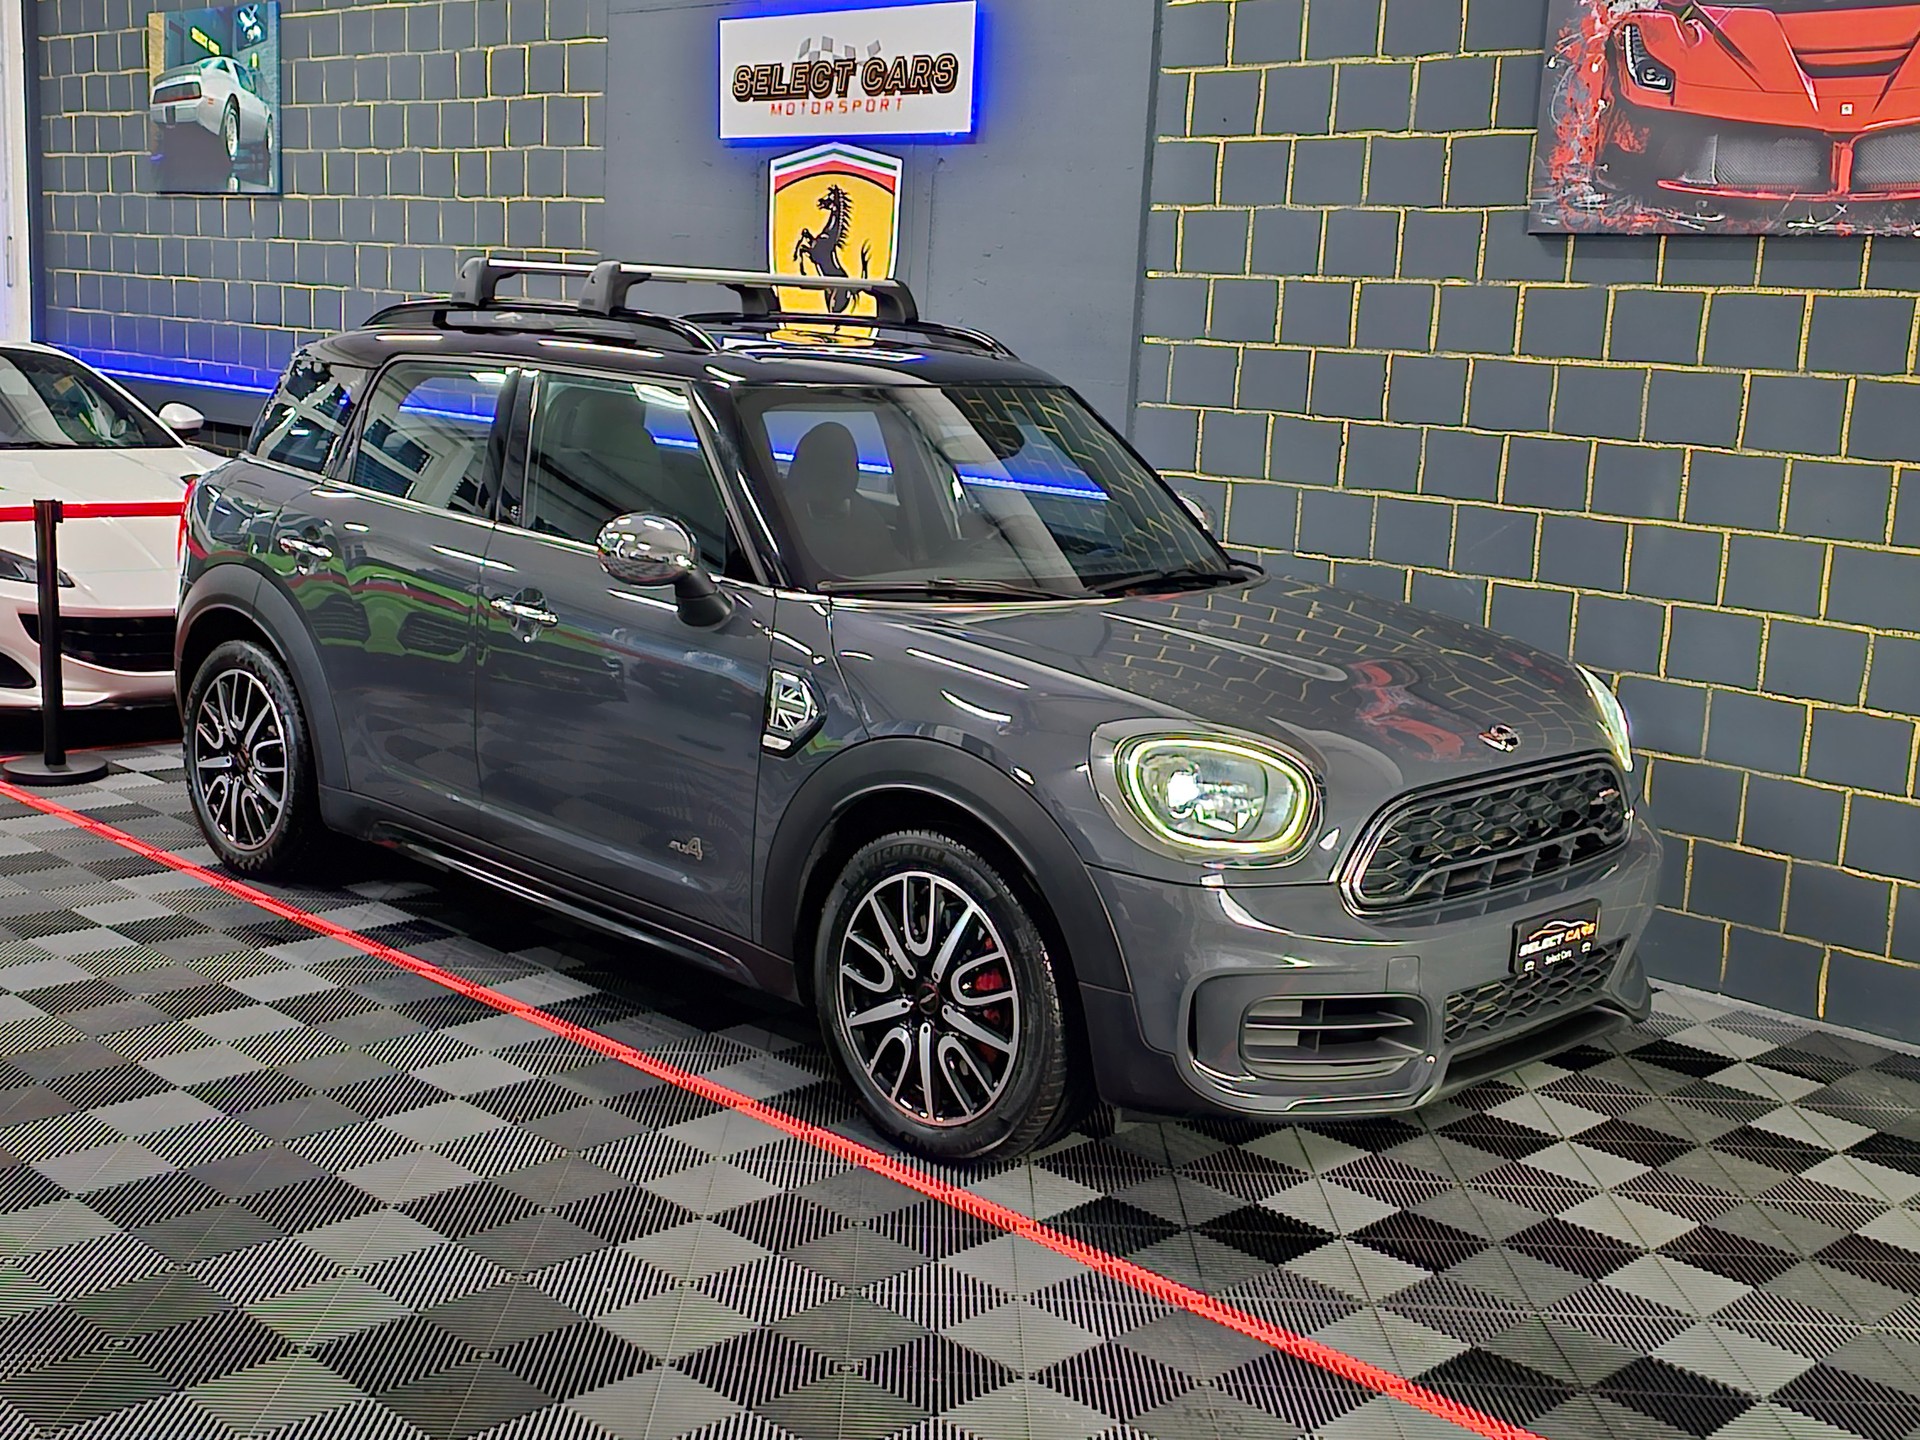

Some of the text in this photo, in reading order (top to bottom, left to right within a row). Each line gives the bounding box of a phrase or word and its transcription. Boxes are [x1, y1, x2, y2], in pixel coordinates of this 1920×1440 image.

[732, 53, 959, 102] SELECT CARS
[769, 97, 903, 117] MOTORSPORT
